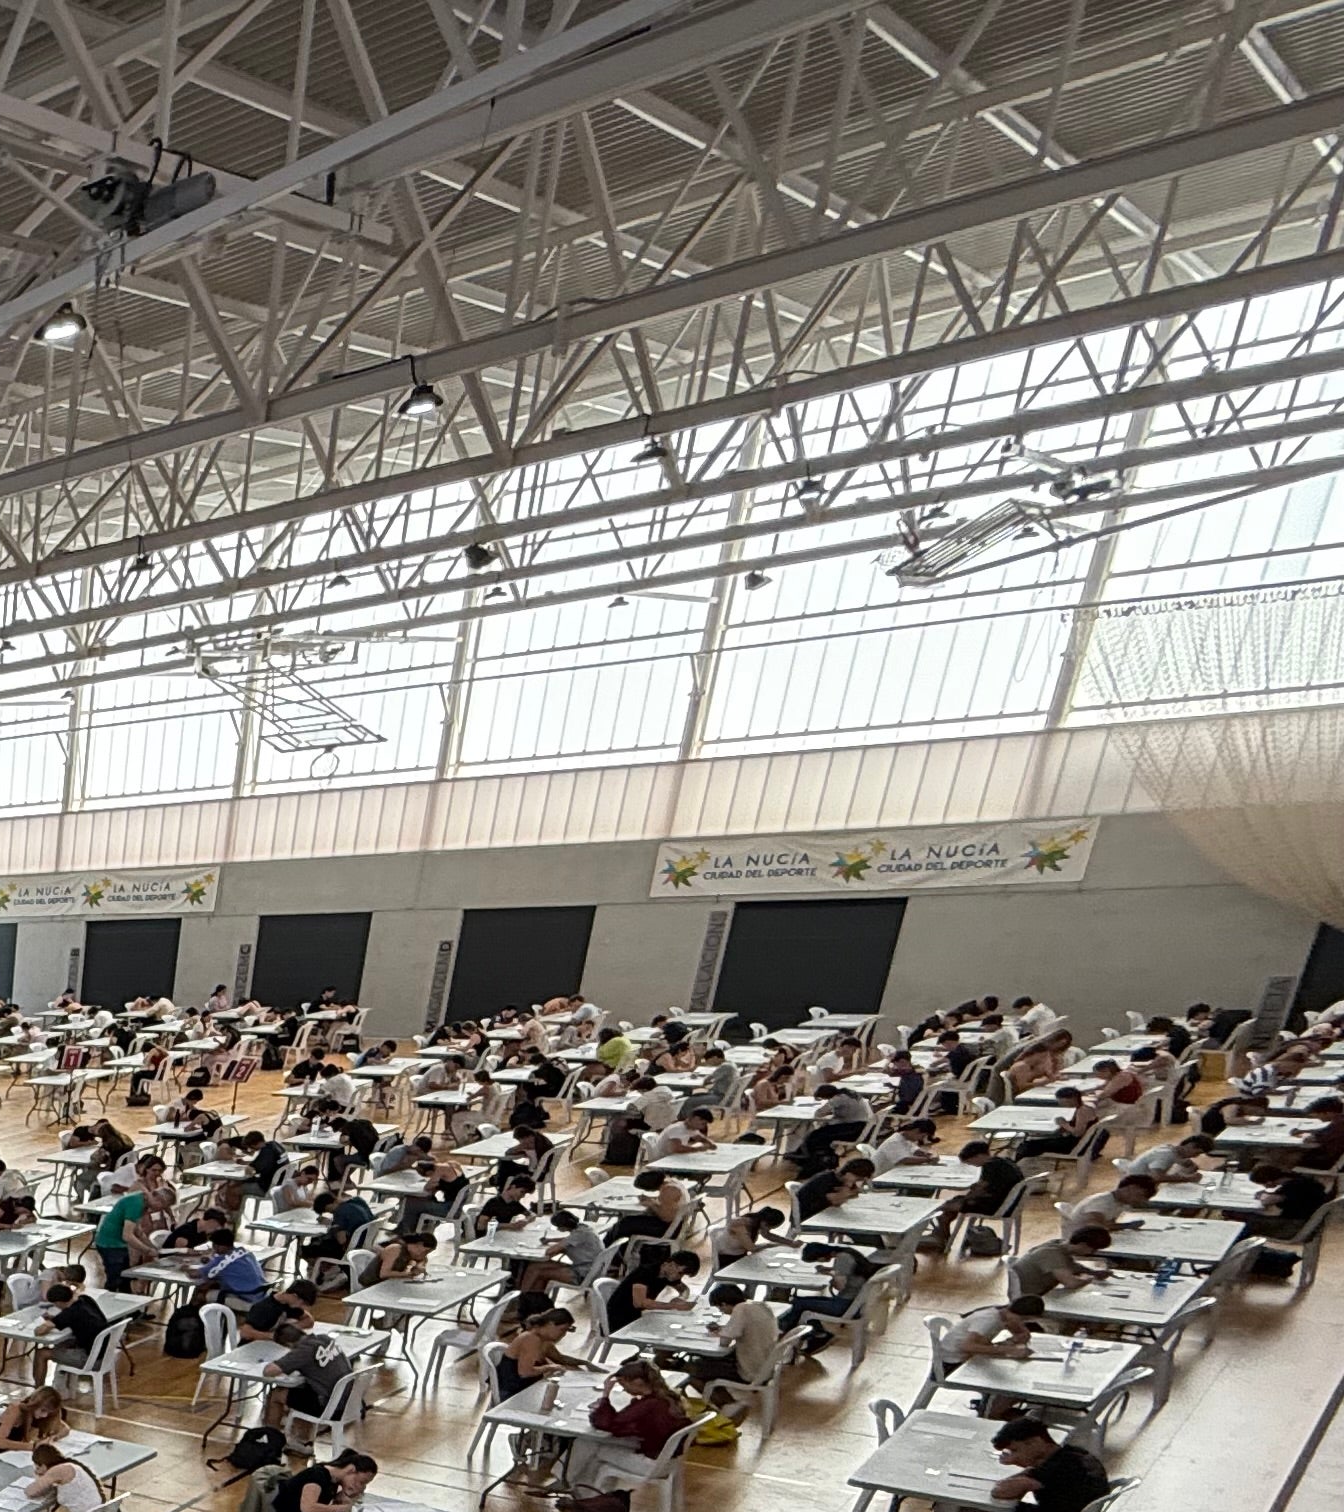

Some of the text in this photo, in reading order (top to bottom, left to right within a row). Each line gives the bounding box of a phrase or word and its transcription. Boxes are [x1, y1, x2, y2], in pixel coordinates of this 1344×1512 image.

[890, 848, 912, 861] LA
[713, 856, 733, 868] LA
[877, 858, 1009, 873] CIUDAD DEL DEPORTE
[703, 867, 817, 880] CIUDAD DEL DEPORTE
[18, 887, 30, 897] LA
[113, 883, 125, 893] LA
[236, 1065, 246, 1077] 2
